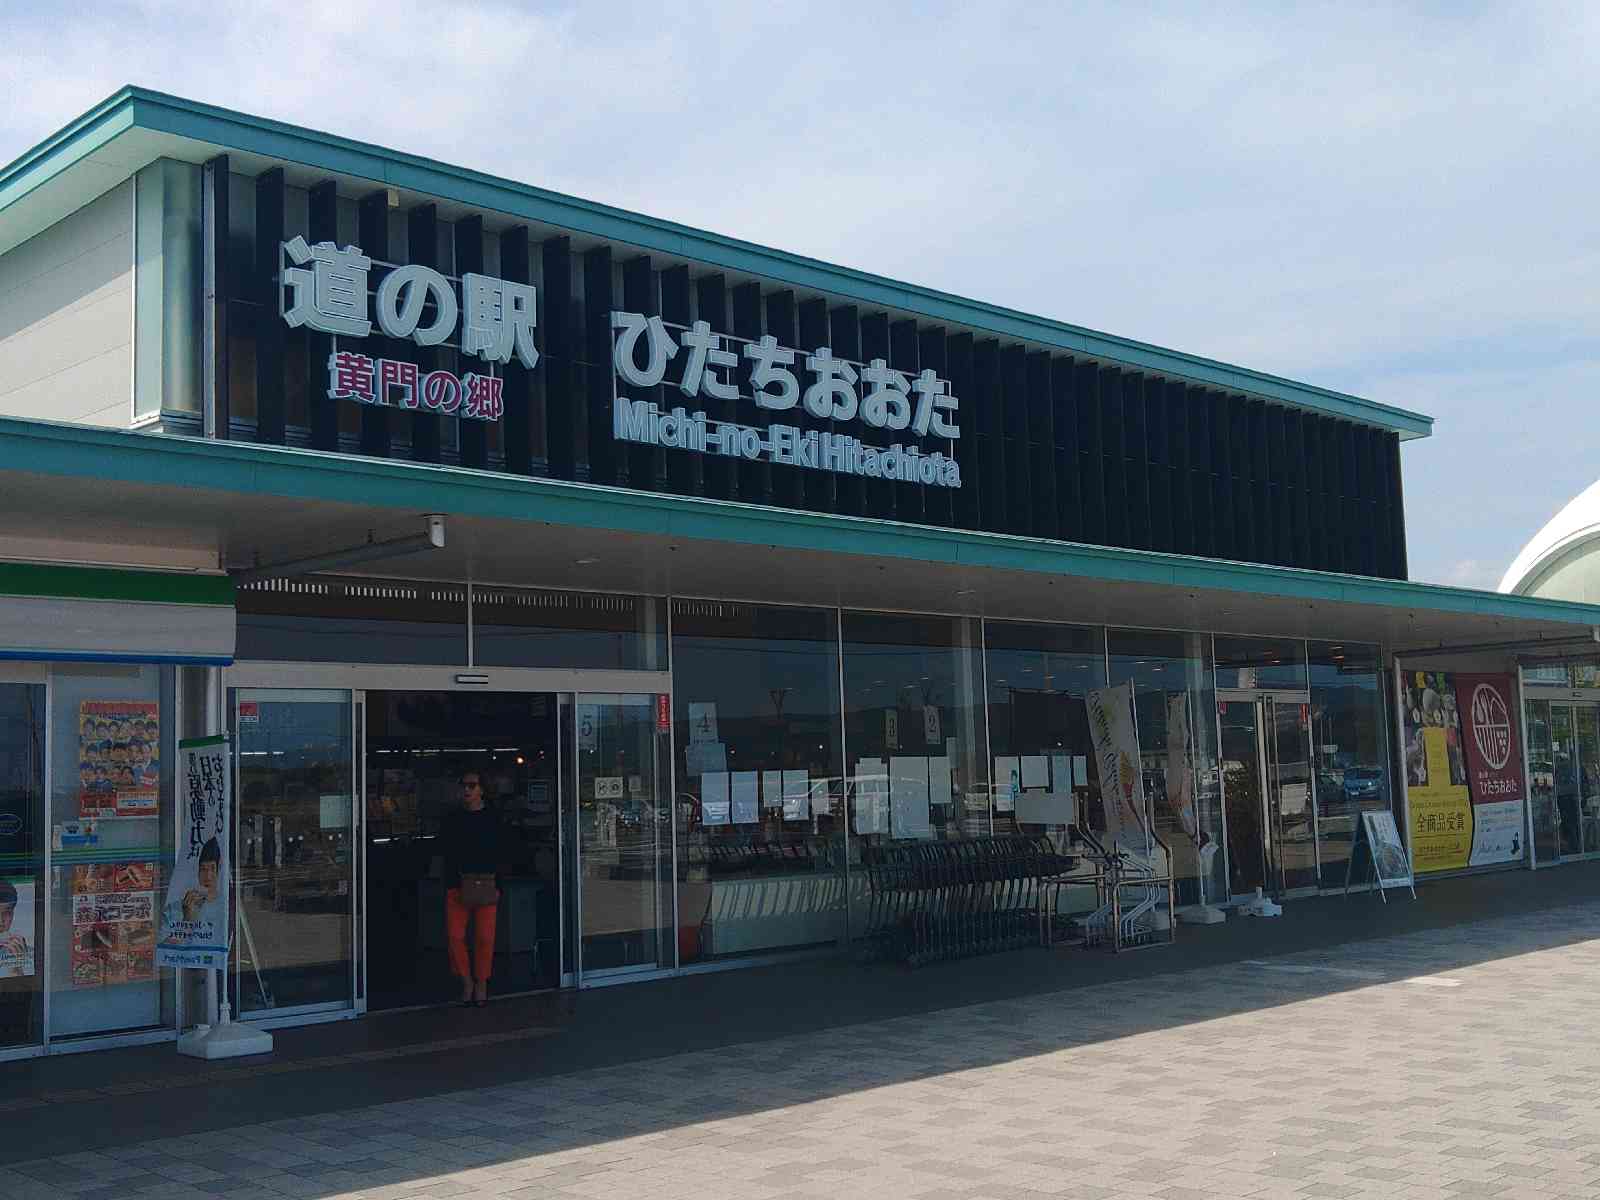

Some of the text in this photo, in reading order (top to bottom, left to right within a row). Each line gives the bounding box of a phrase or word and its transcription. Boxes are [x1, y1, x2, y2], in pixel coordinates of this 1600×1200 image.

[282, 235, 540, 369] 道の駅
[327, 351, 504, 421] 黄門の郷
[611, 311, 961, 439] ひたちおおた
[614, 397, 962, 488] Michi-no-Eki Hitachiota
